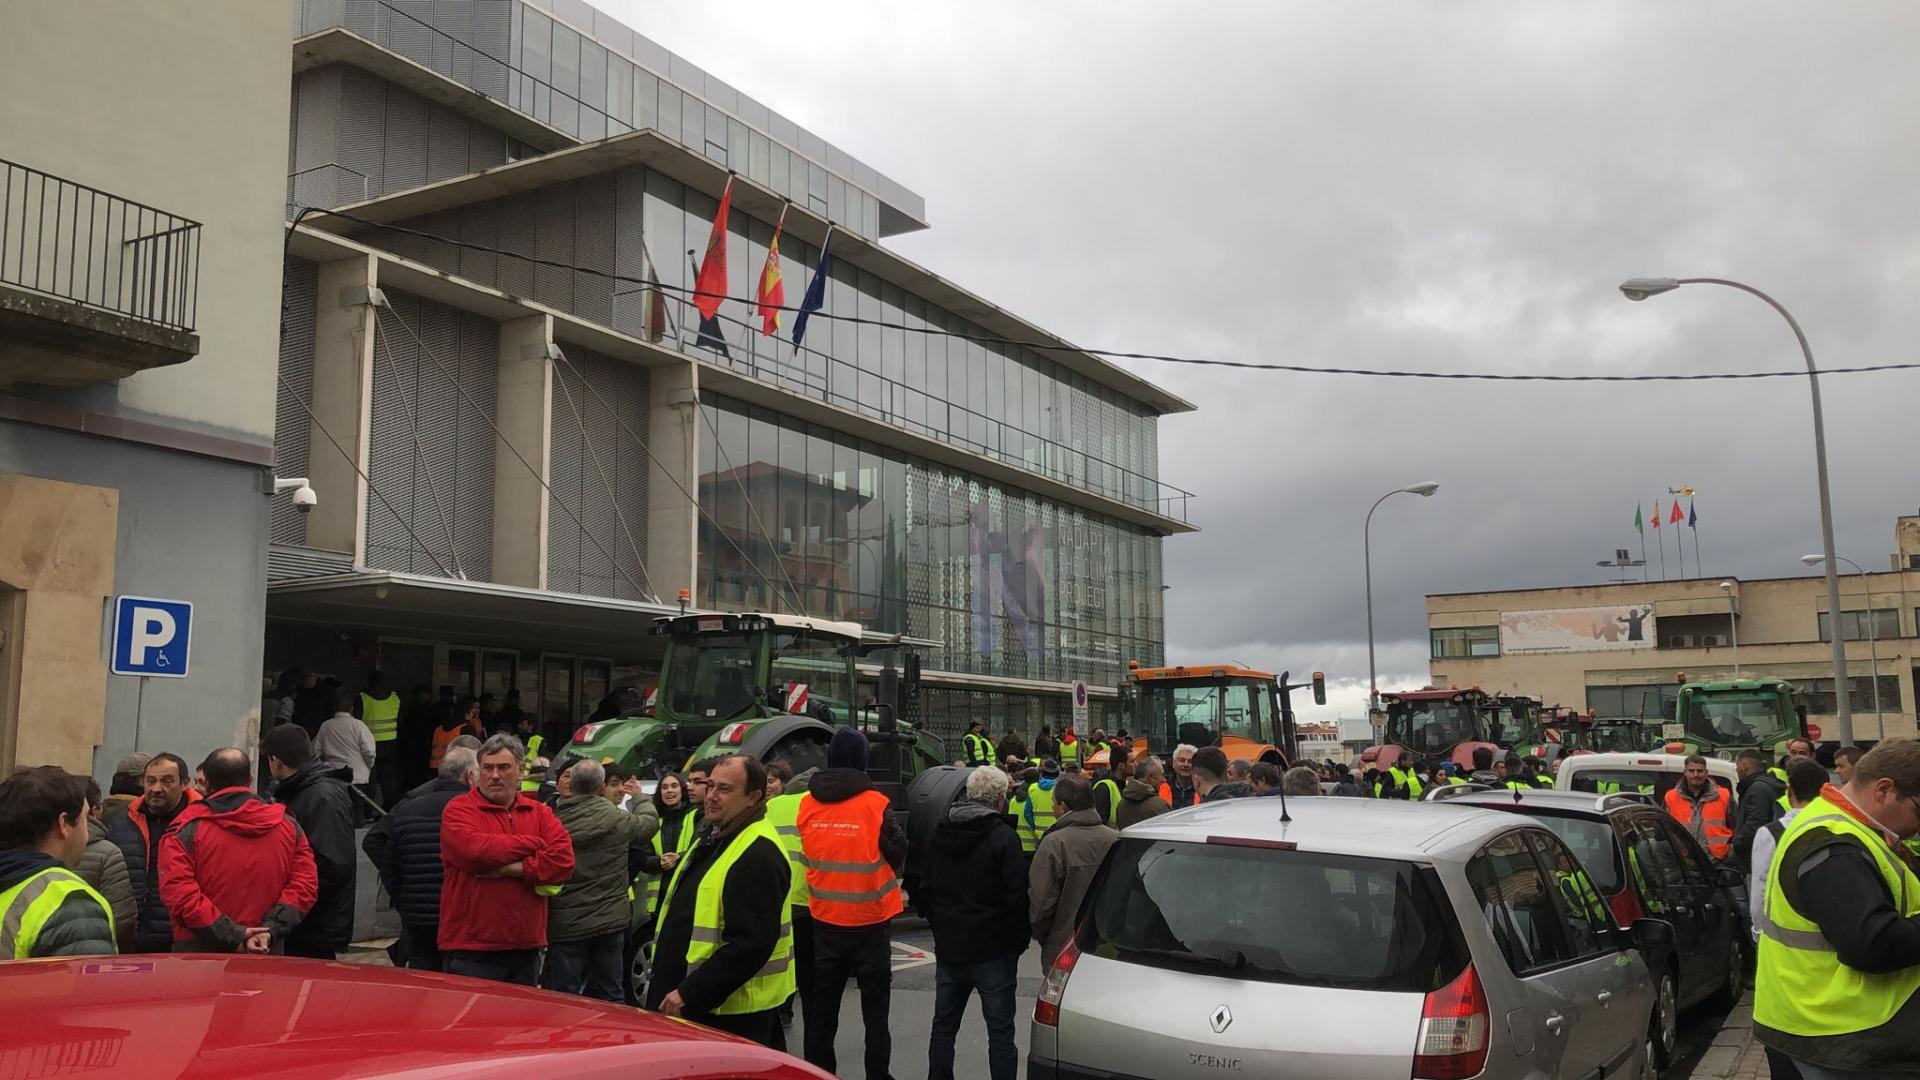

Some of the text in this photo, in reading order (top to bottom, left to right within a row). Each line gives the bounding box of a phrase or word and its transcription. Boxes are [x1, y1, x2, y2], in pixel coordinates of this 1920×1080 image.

[1059, 580, 1105, 608] PROJECT
[130, 607, 176, 665] P
[1189, 1053, 1242, 1071] SCENIC
